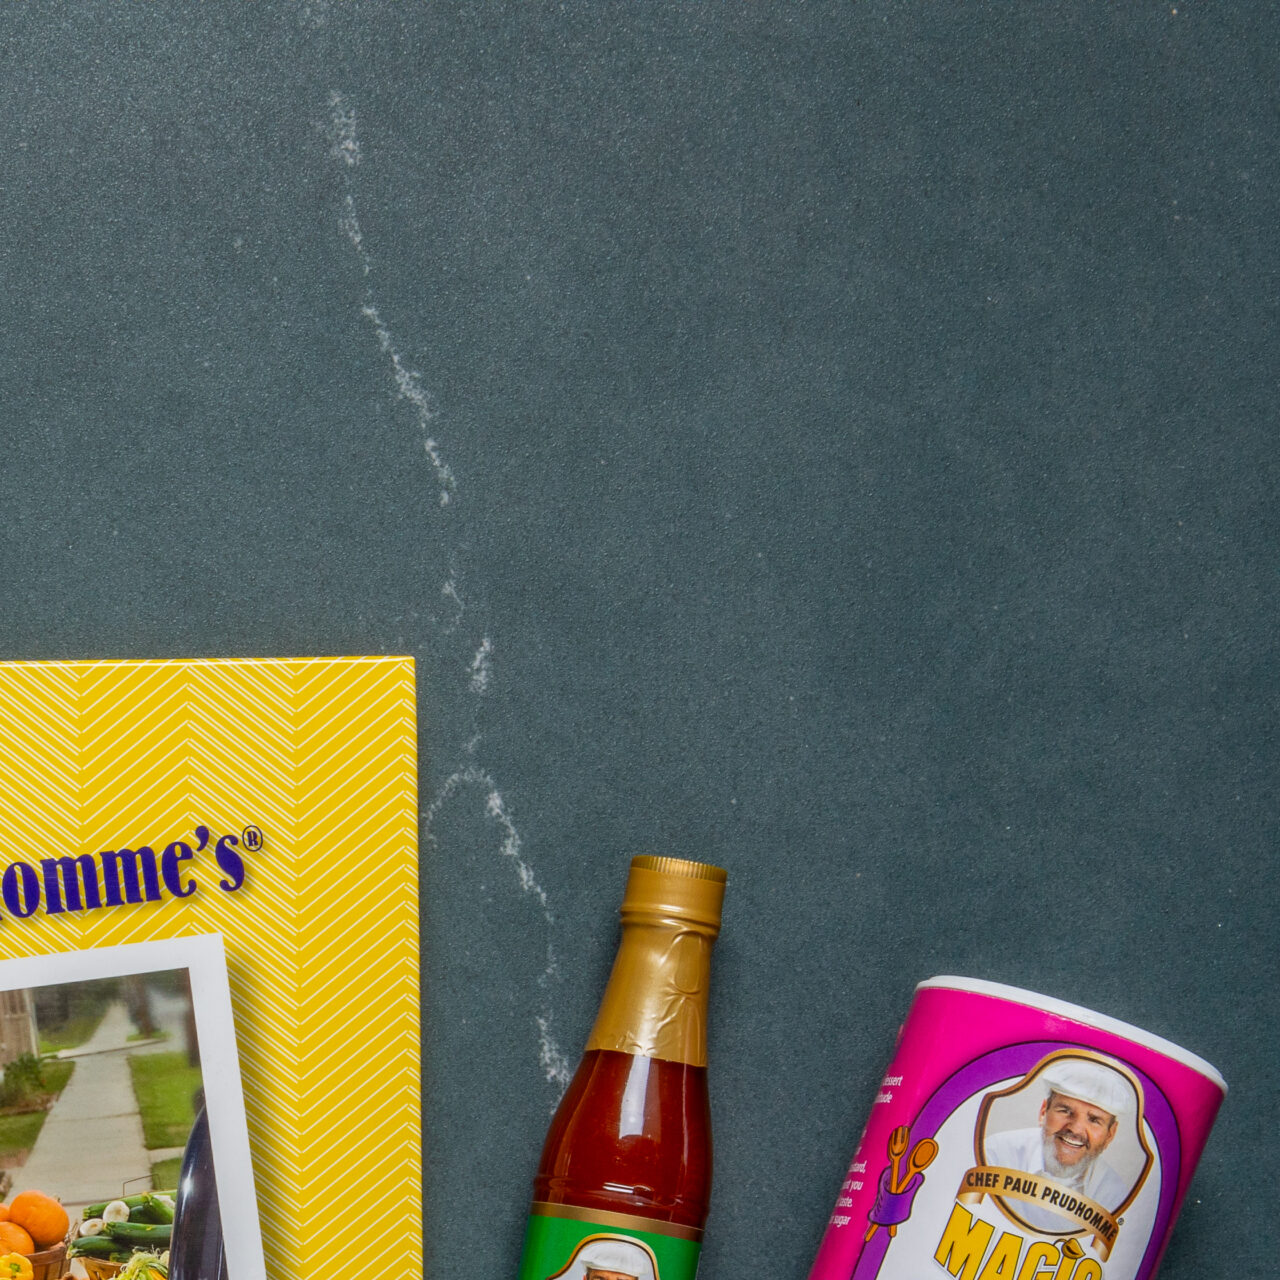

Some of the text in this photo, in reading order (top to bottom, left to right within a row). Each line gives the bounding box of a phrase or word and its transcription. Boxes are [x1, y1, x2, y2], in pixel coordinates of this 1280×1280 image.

[966, 1172, 1118, 1243] CHEF PAUL PRUDHOMME
